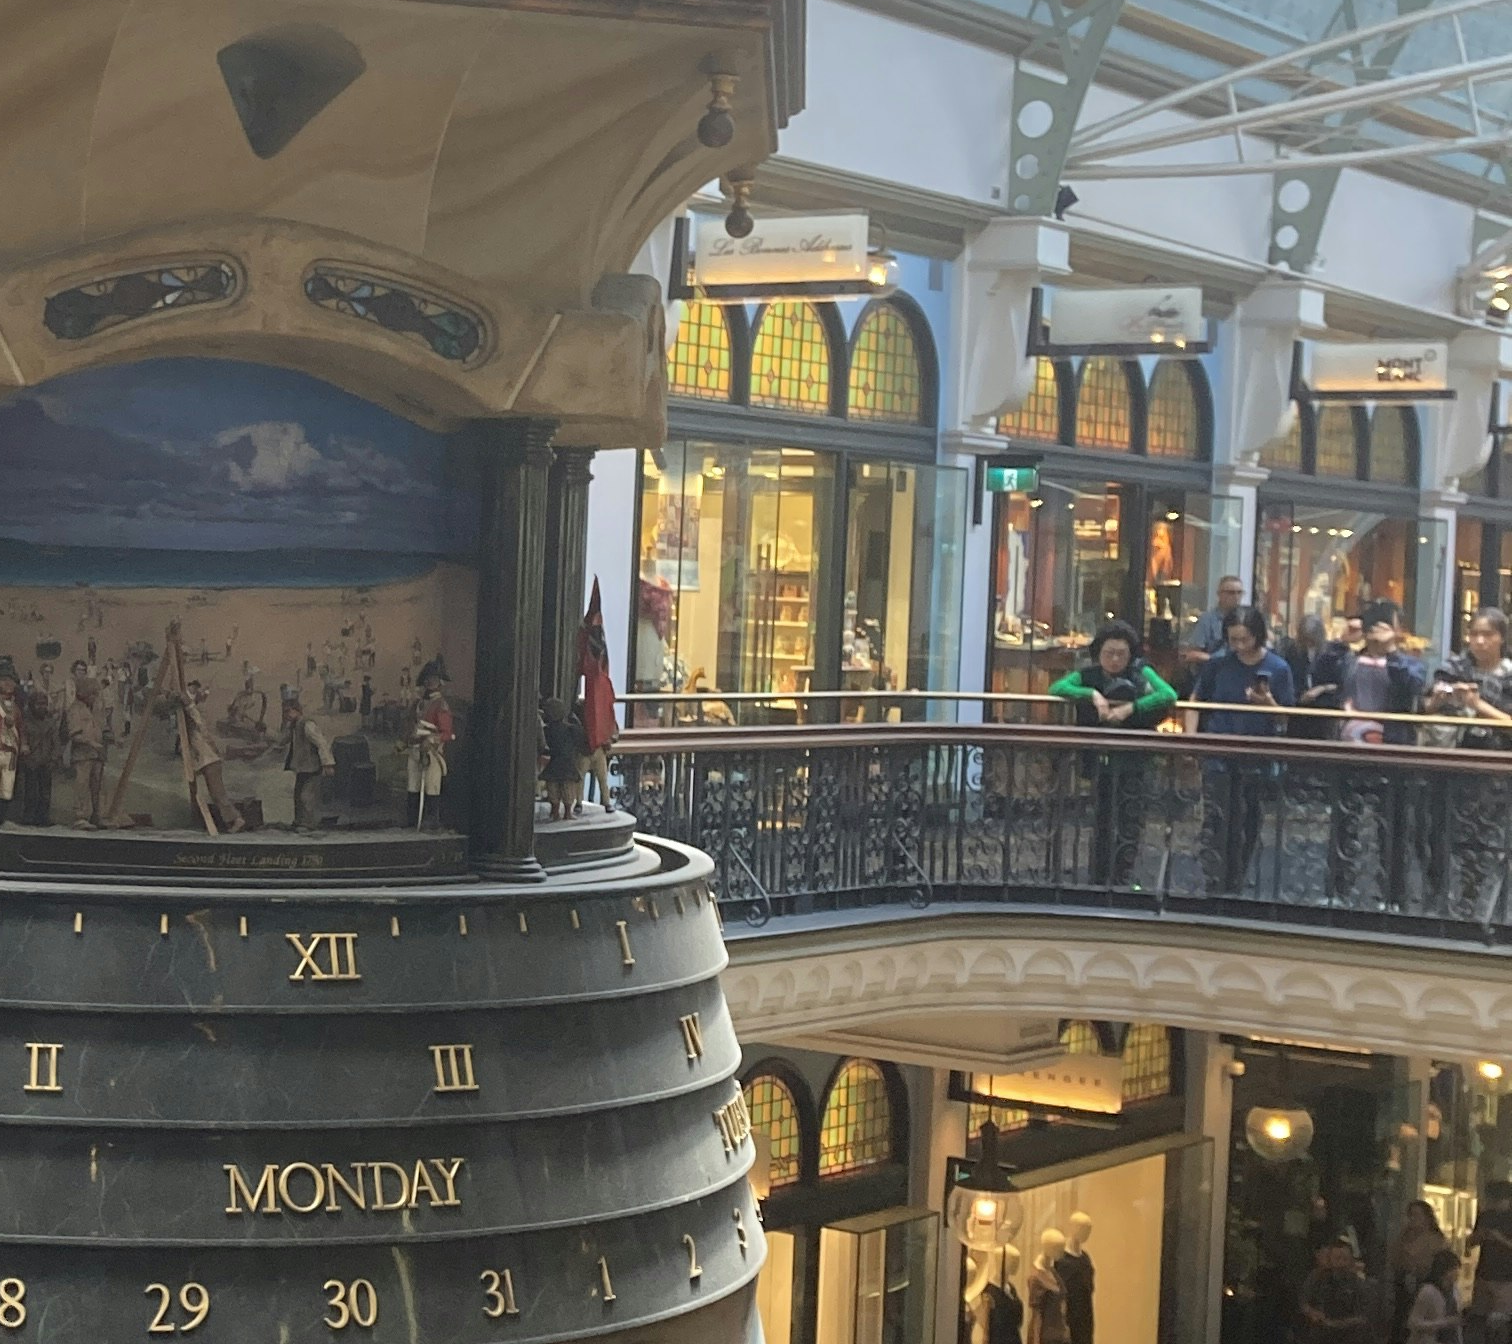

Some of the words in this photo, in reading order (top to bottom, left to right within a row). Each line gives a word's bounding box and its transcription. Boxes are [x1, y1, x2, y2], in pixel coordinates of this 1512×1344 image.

[286, 932, 362, 981] XII
[616, 920, 635, 966] I
[24, 1042, 64, 1092] II
[429, 1043, 480, 1093] III
[223, 1157, 466, 1215] MONDAY
[144, 1282, 211, 1333] 29
[323, 1278, 379, 1329] 30
[480, 1267, 520, 1318] 31
[597, 1255, 617, 1303] 1
[683, 1233, 704, 1279] 2
